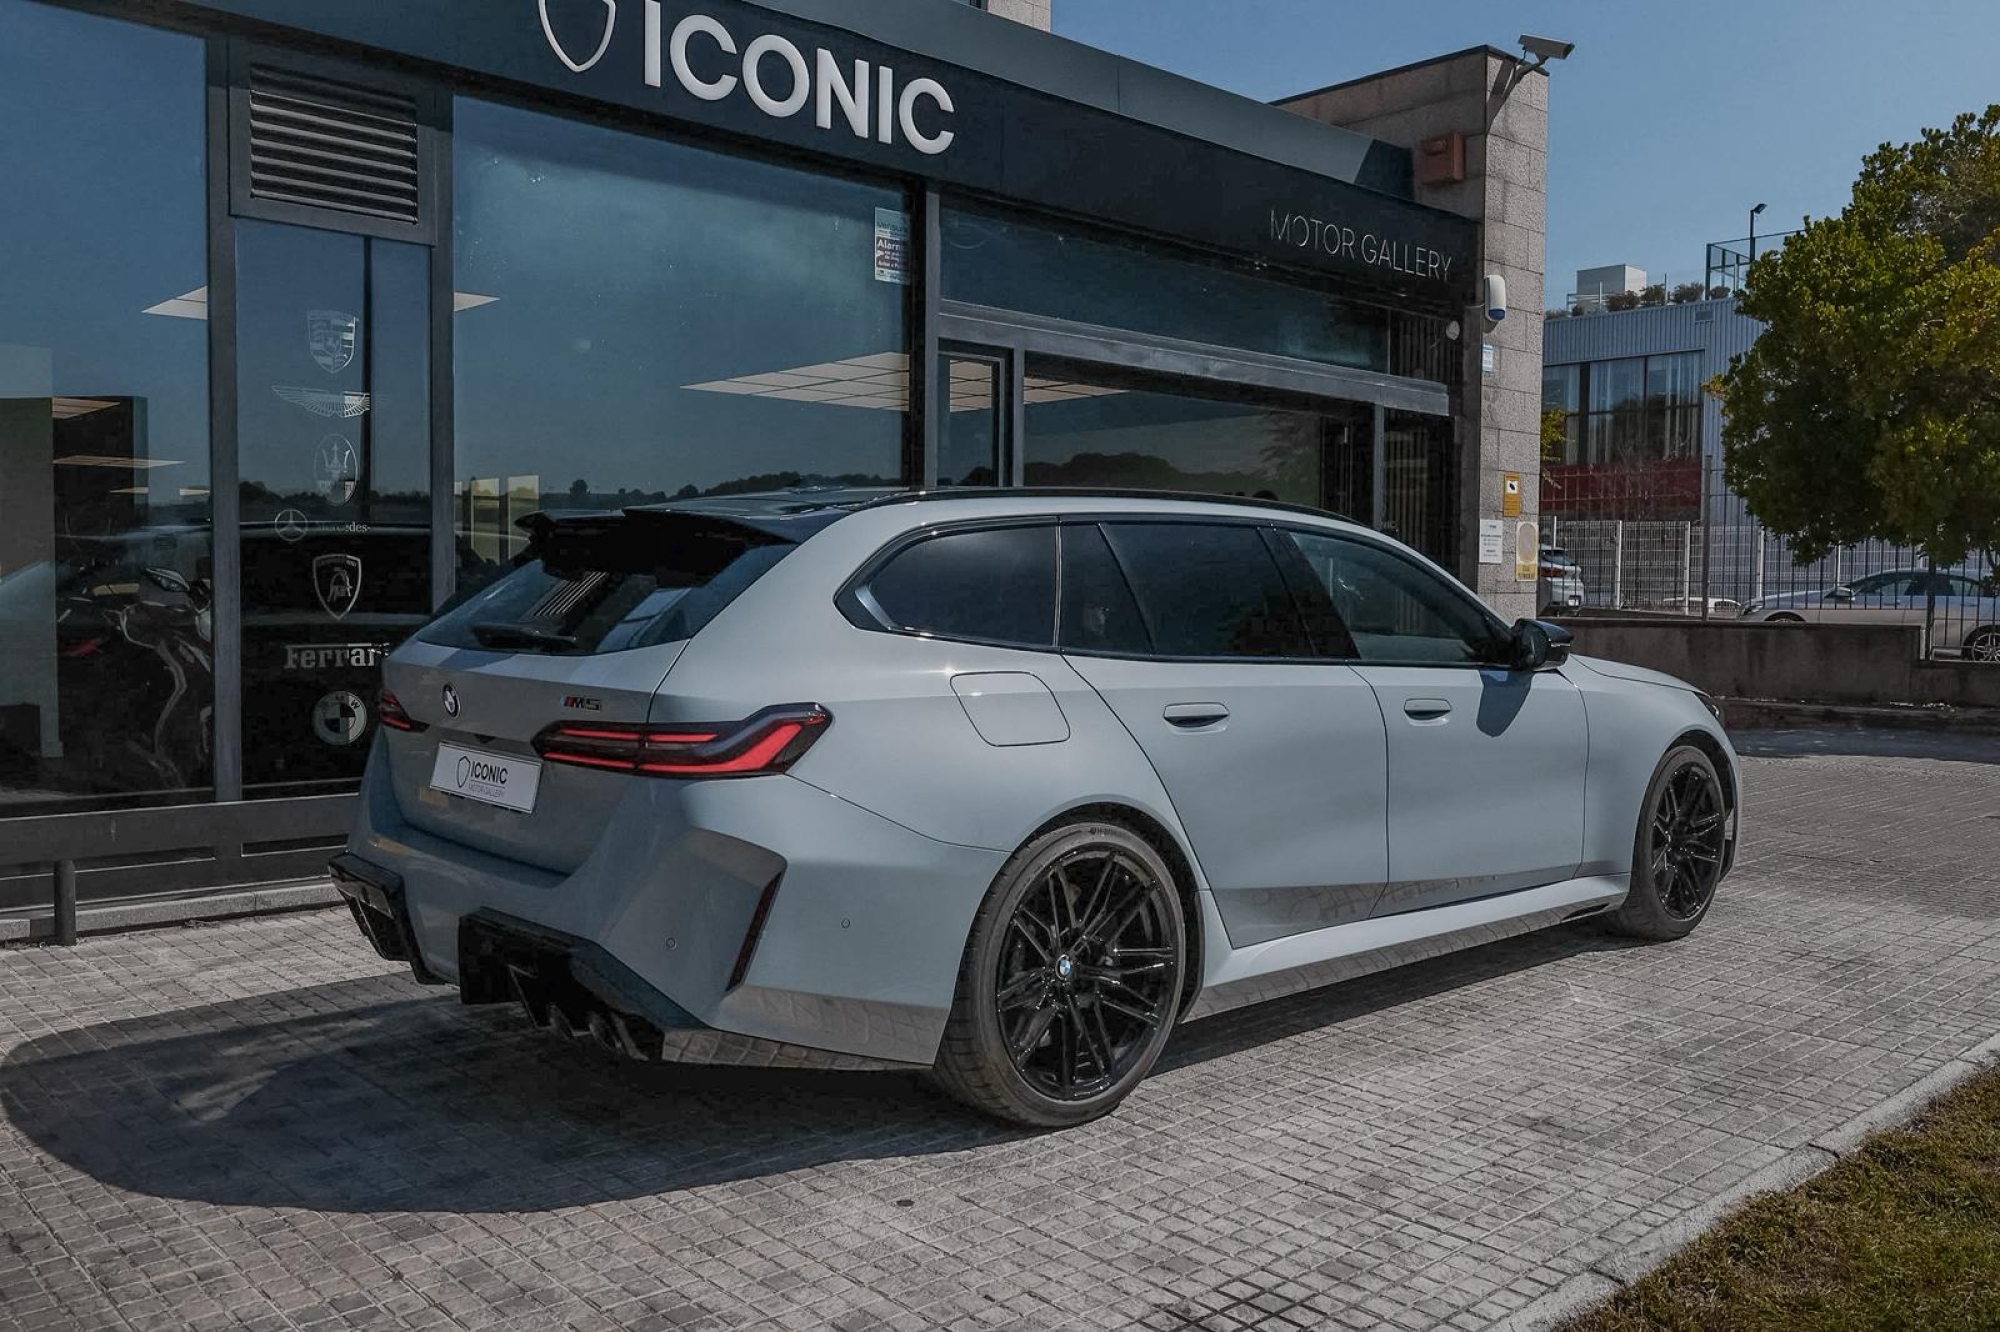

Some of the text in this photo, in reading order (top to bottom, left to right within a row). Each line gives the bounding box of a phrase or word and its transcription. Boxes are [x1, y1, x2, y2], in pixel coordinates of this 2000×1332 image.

[644, 0, 955, 155] ICONIC
[1270, 209, 1452, 282] MOTOR GALLERY
[470, 760, 508, 784] ICONIC
